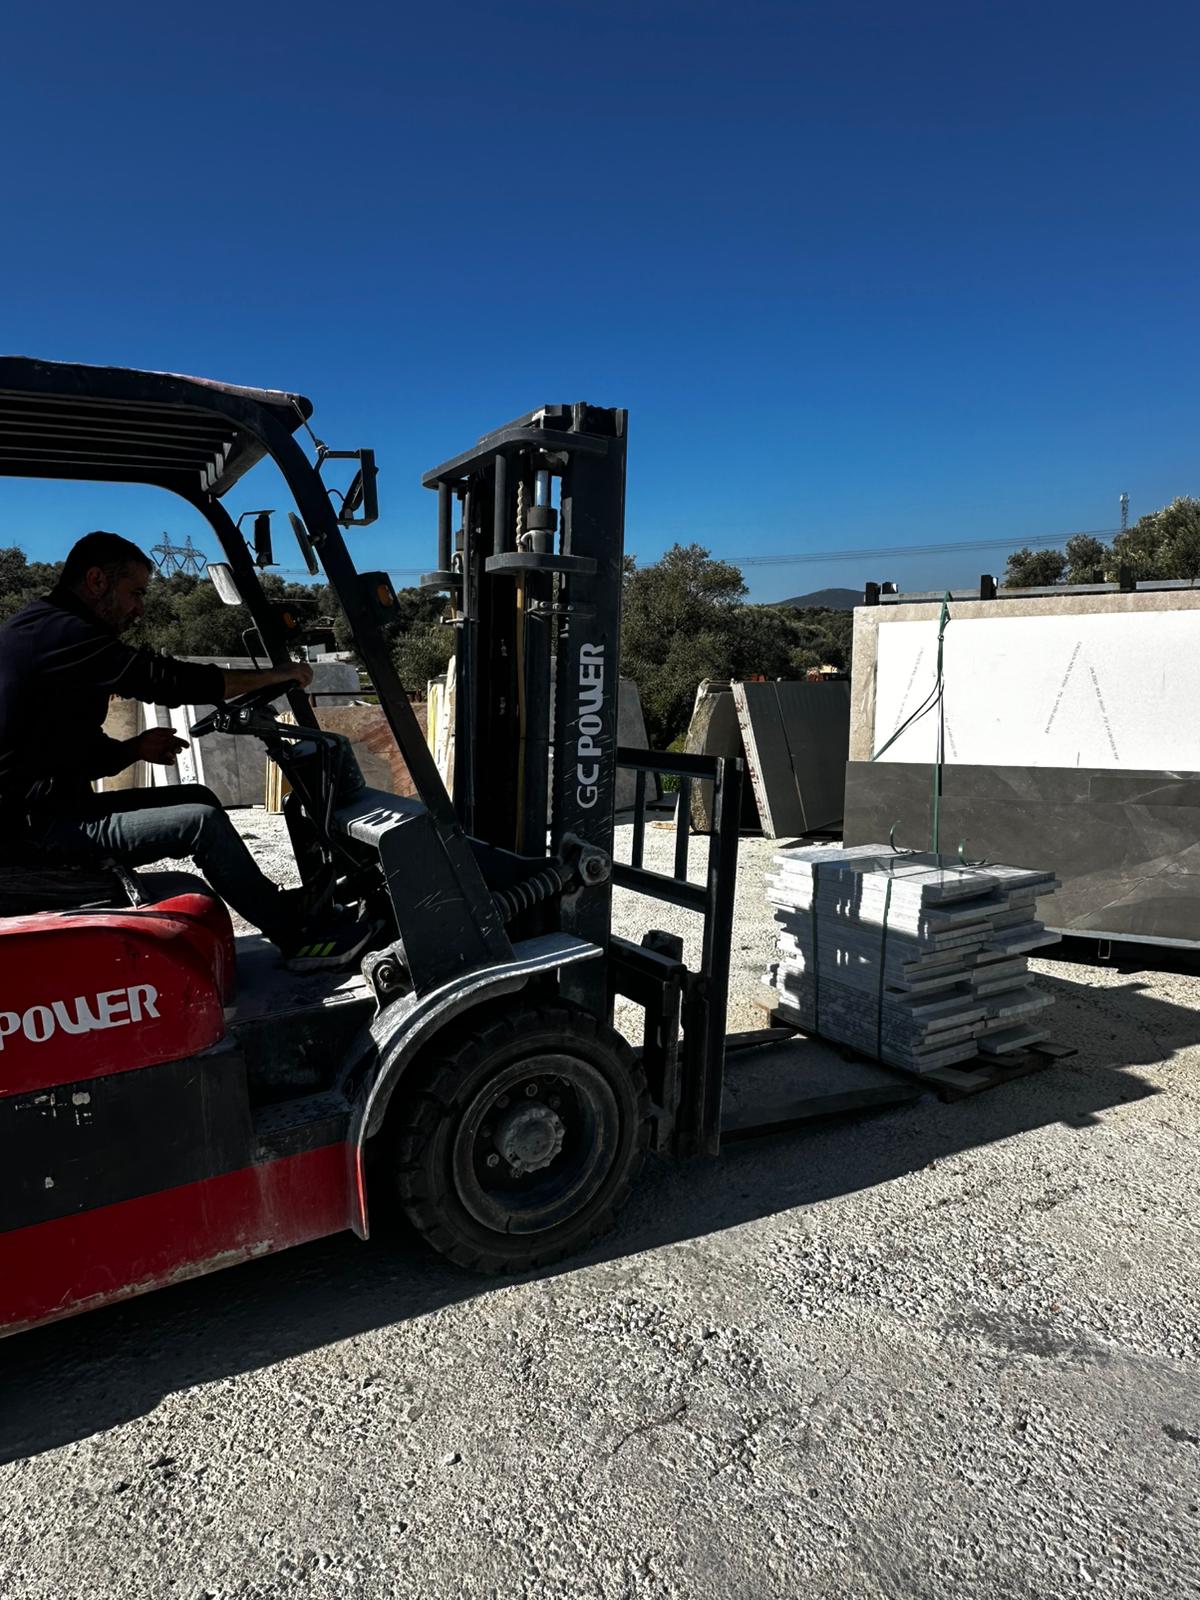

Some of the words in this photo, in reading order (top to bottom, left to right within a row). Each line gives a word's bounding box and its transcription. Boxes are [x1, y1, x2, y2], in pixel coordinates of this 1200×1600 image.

[577, 643, 605, 757] POWER
[576, 763, 600, 809] GC
[0, 983, 161, 1051] POWER
